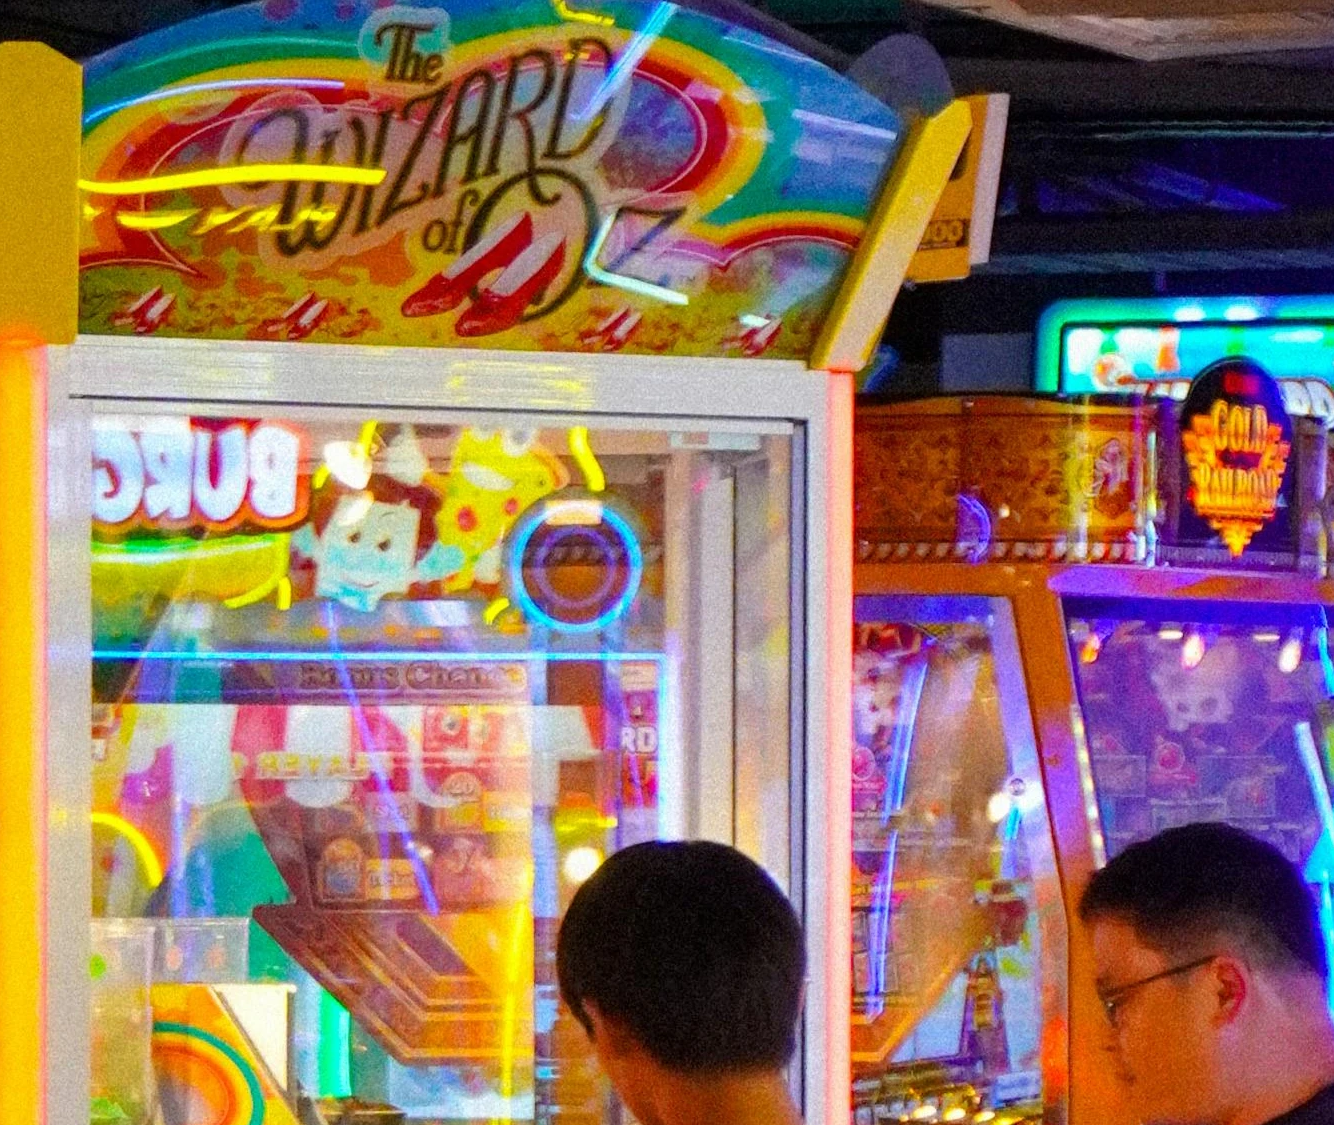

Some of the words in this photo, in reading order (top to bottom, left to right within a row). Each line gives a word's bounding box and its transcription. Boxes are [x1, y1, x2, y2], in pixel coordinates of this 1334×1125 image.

[374, 22, 445, 84] The
[422, 187, 474, 256] of
[1212, 400, 1267, 451] GOLD
